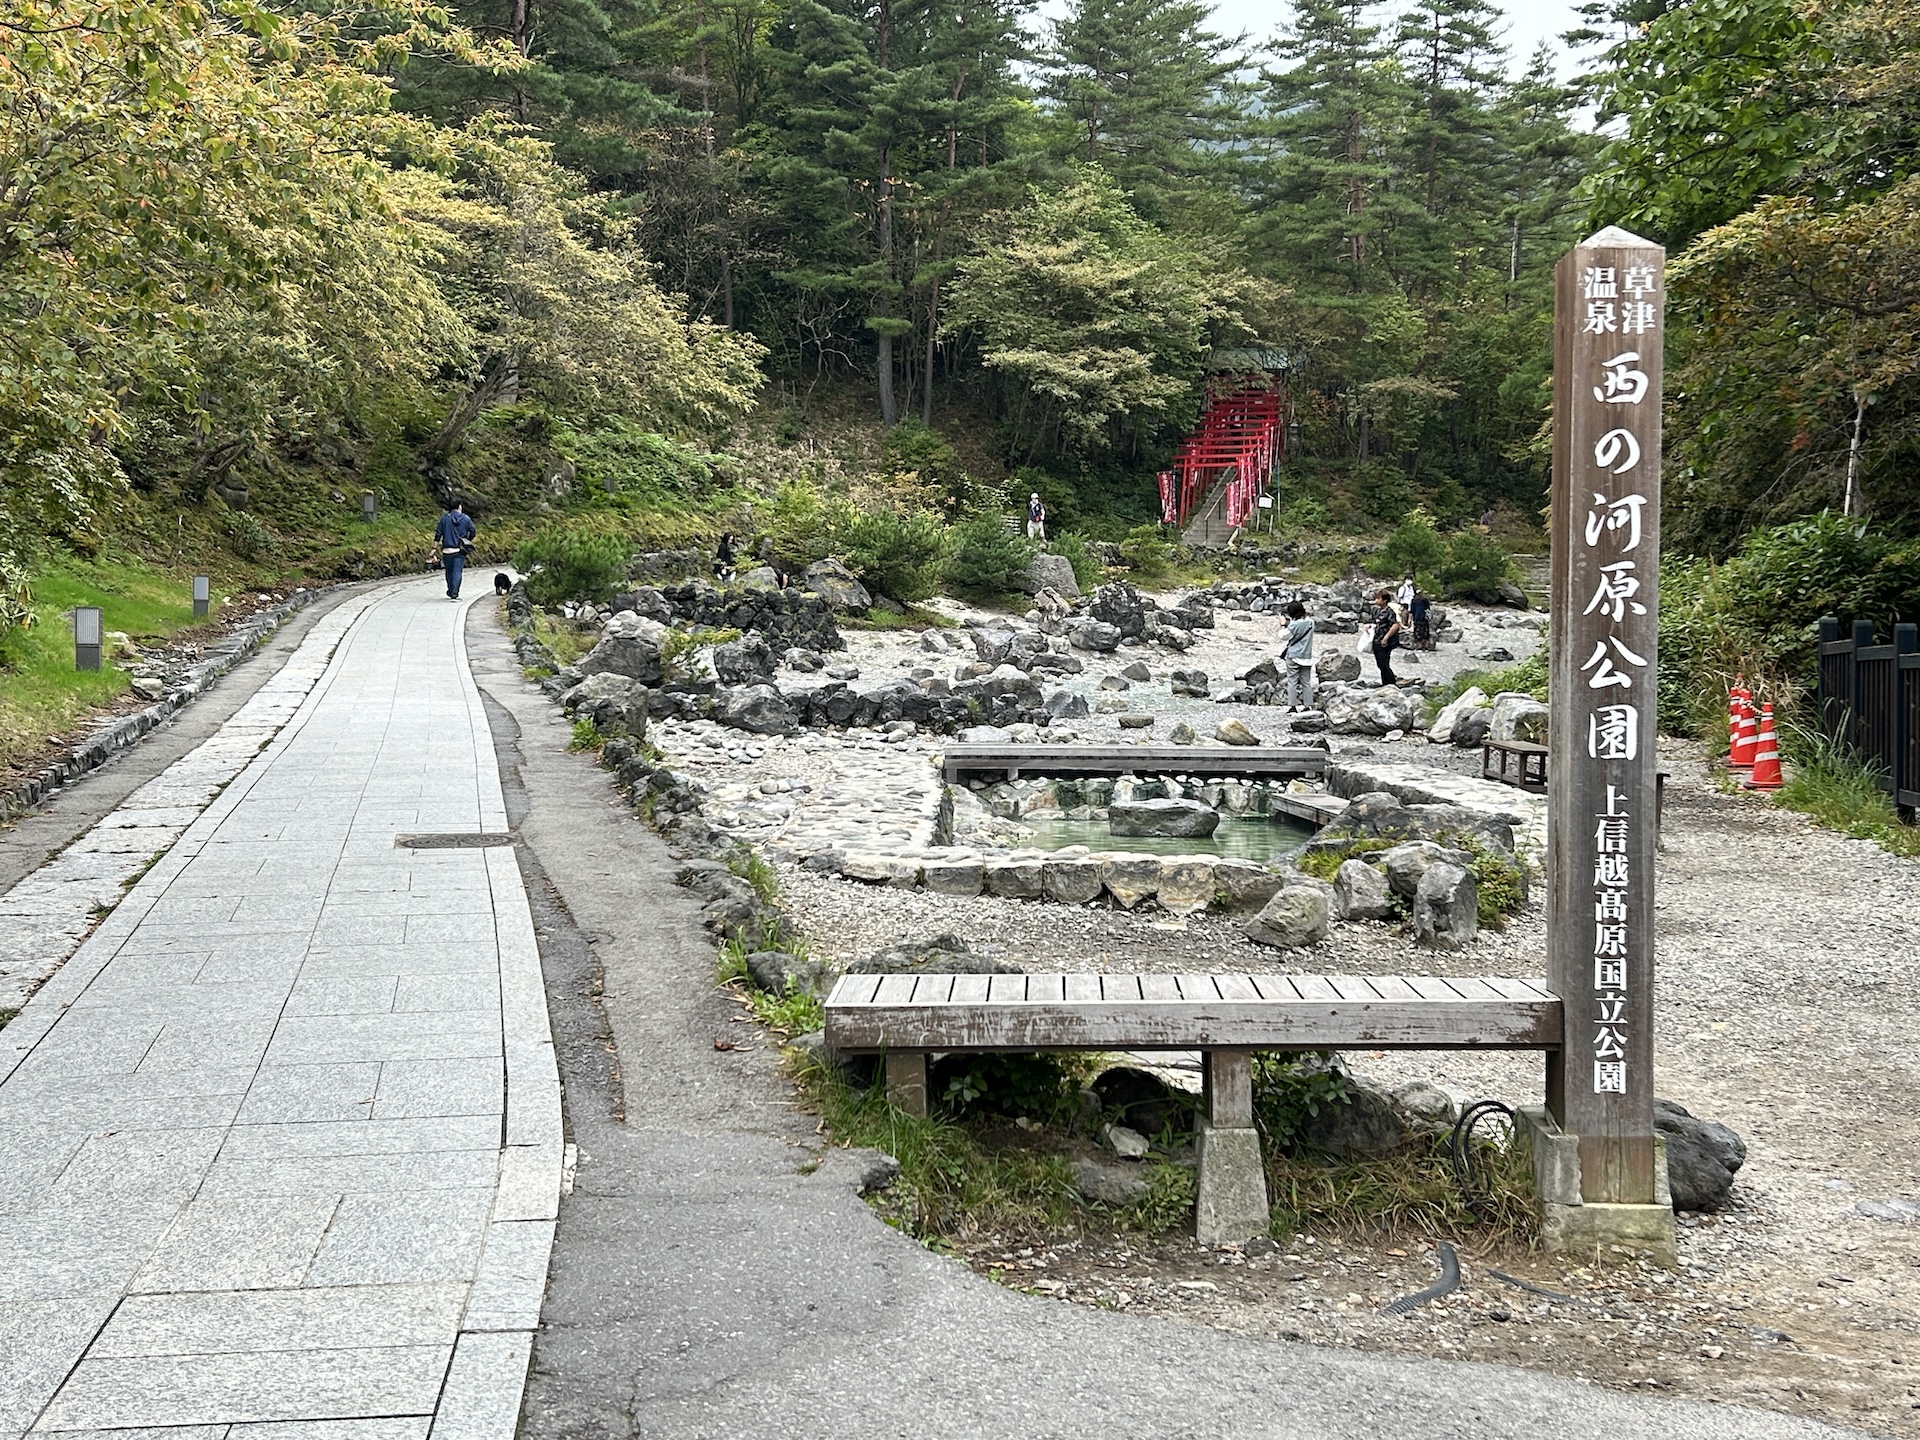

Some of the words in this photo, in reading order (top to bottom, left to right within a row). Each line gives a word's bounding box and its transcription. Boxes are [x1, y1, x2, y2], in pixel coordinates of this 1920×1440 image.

[1582, 266, 1619, 335] 温泉
[1621, 264, 1657, 335] 草津
[1581, 351, 1649, 761] 西の河原公園
